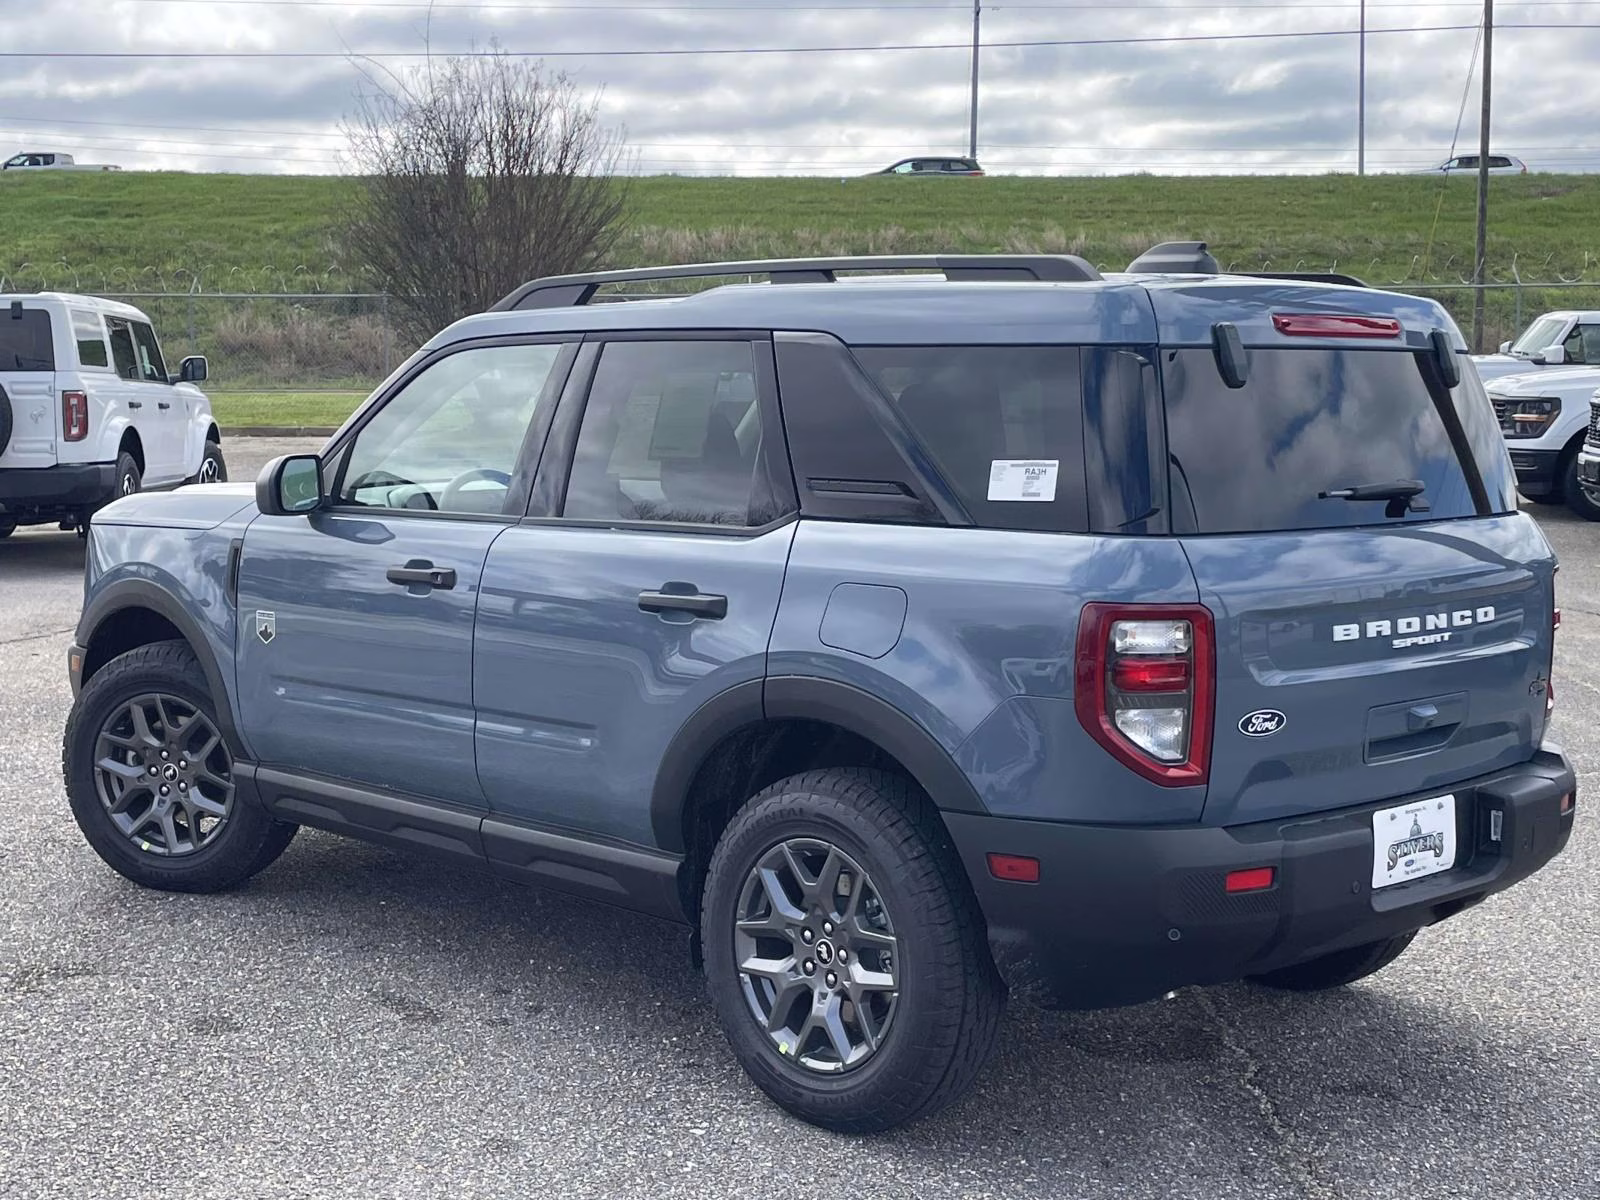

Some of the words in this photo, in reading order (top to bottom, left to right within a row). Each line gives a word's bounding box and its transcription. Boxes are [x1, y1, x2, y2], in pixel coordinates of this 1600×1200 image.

[1332, 606, 1495, 642] BRONCO
[1392, 632, 1452, 649] SPORT
[1248, 713, 1279, 732] Ford
[1387, 832, 1444, 871] STIVERS
